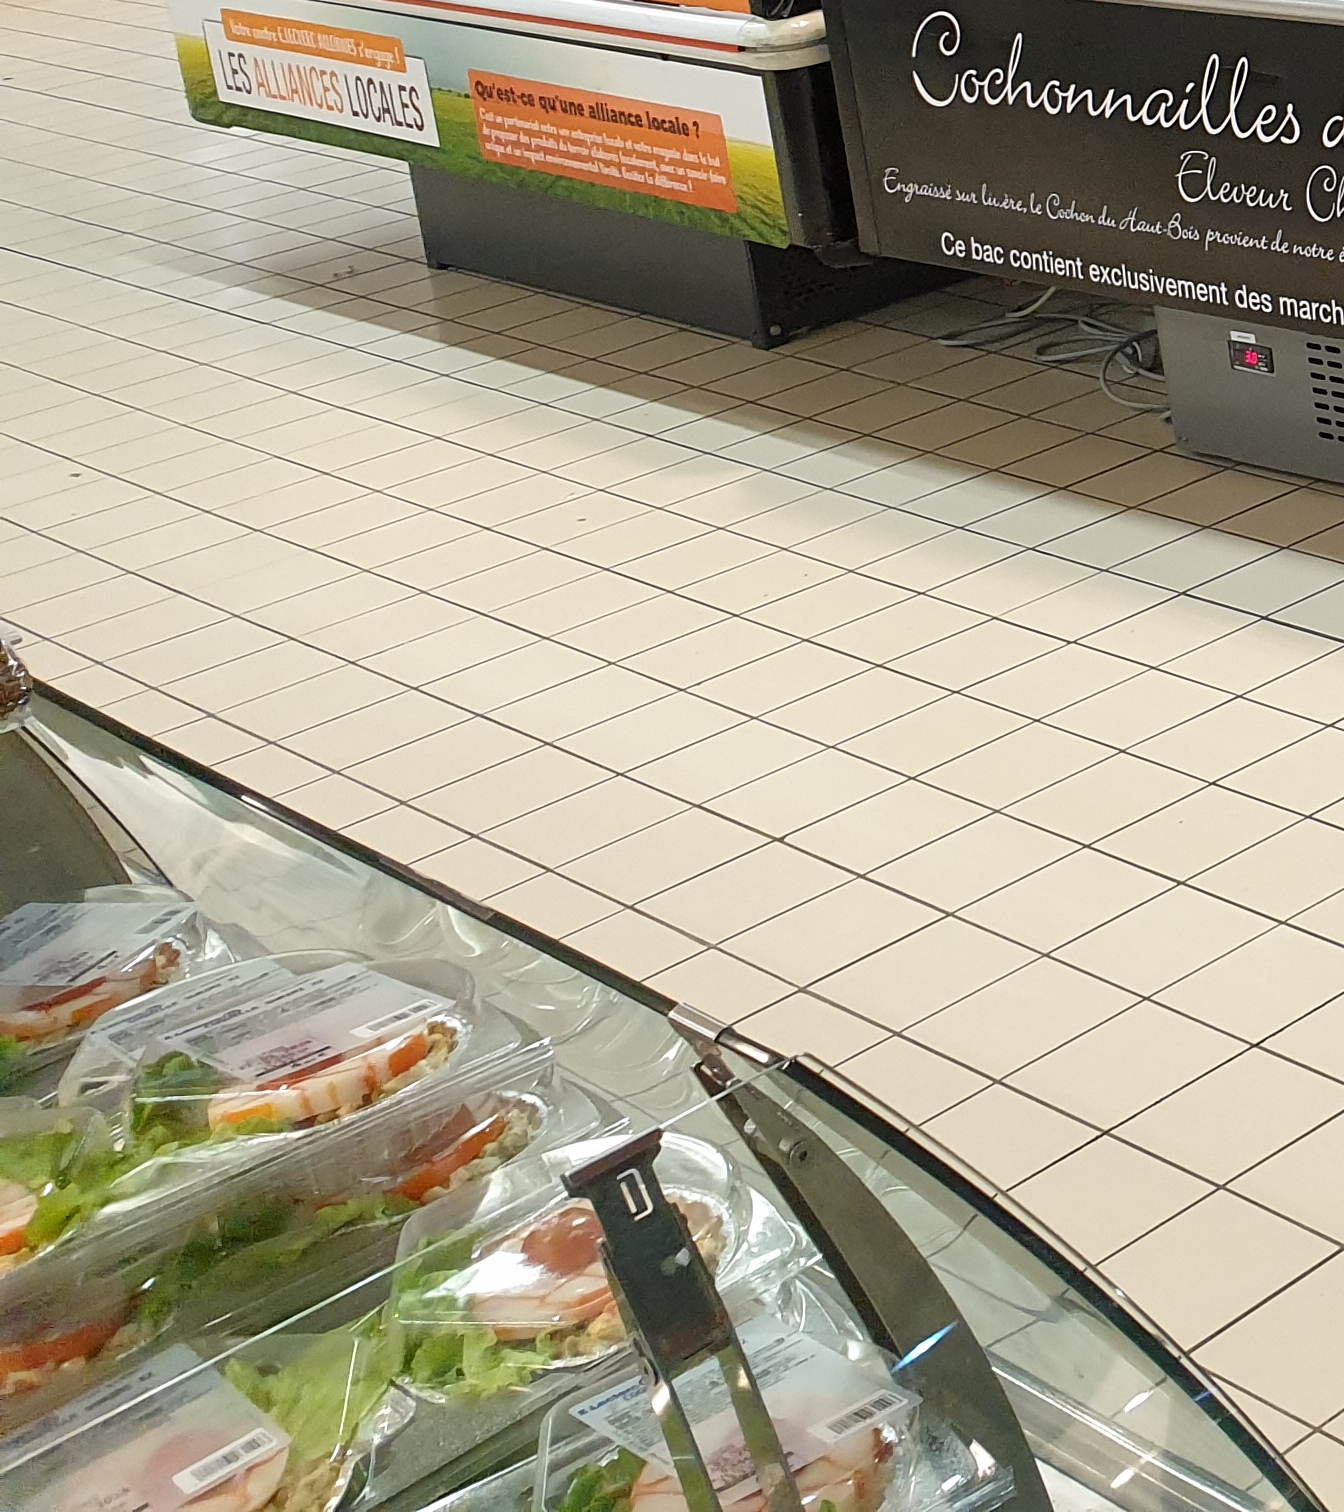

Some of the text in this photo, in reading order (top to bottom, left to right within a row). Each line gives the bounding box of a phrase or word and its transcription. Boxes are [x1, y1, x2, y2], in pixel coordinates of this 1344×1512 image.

[218, 48, 424, 132] LES ALLIANCES LOCALES
[474, 79, 689, 137] Qu'est-ce qu'une alliance locale
[912, 10, 1302, 146] Cochonnailles
[882, 167, 953, 203] Engraissé
[955, 187, 978, 204] sur
[1046, 193, 1095, 224] Cochon
[1098, 206, 1117, 228] du
[1119, 207, 1200, 241] Haut-Bois
[1204, 227, 1269, 251] provient
[1270, 229, 1289, 254] de
[1293, 242, 1336, 261] notre
[1174, 150, 1294, 213] Eleveur
[940, 231, 967, 258] Ce
[970, 237, 1005, 264] bac
[1009, 248, 1084, 280] contient
[1088, 264, 1229, 306] exclusivement
[1235, 285, 1273, 313] des
